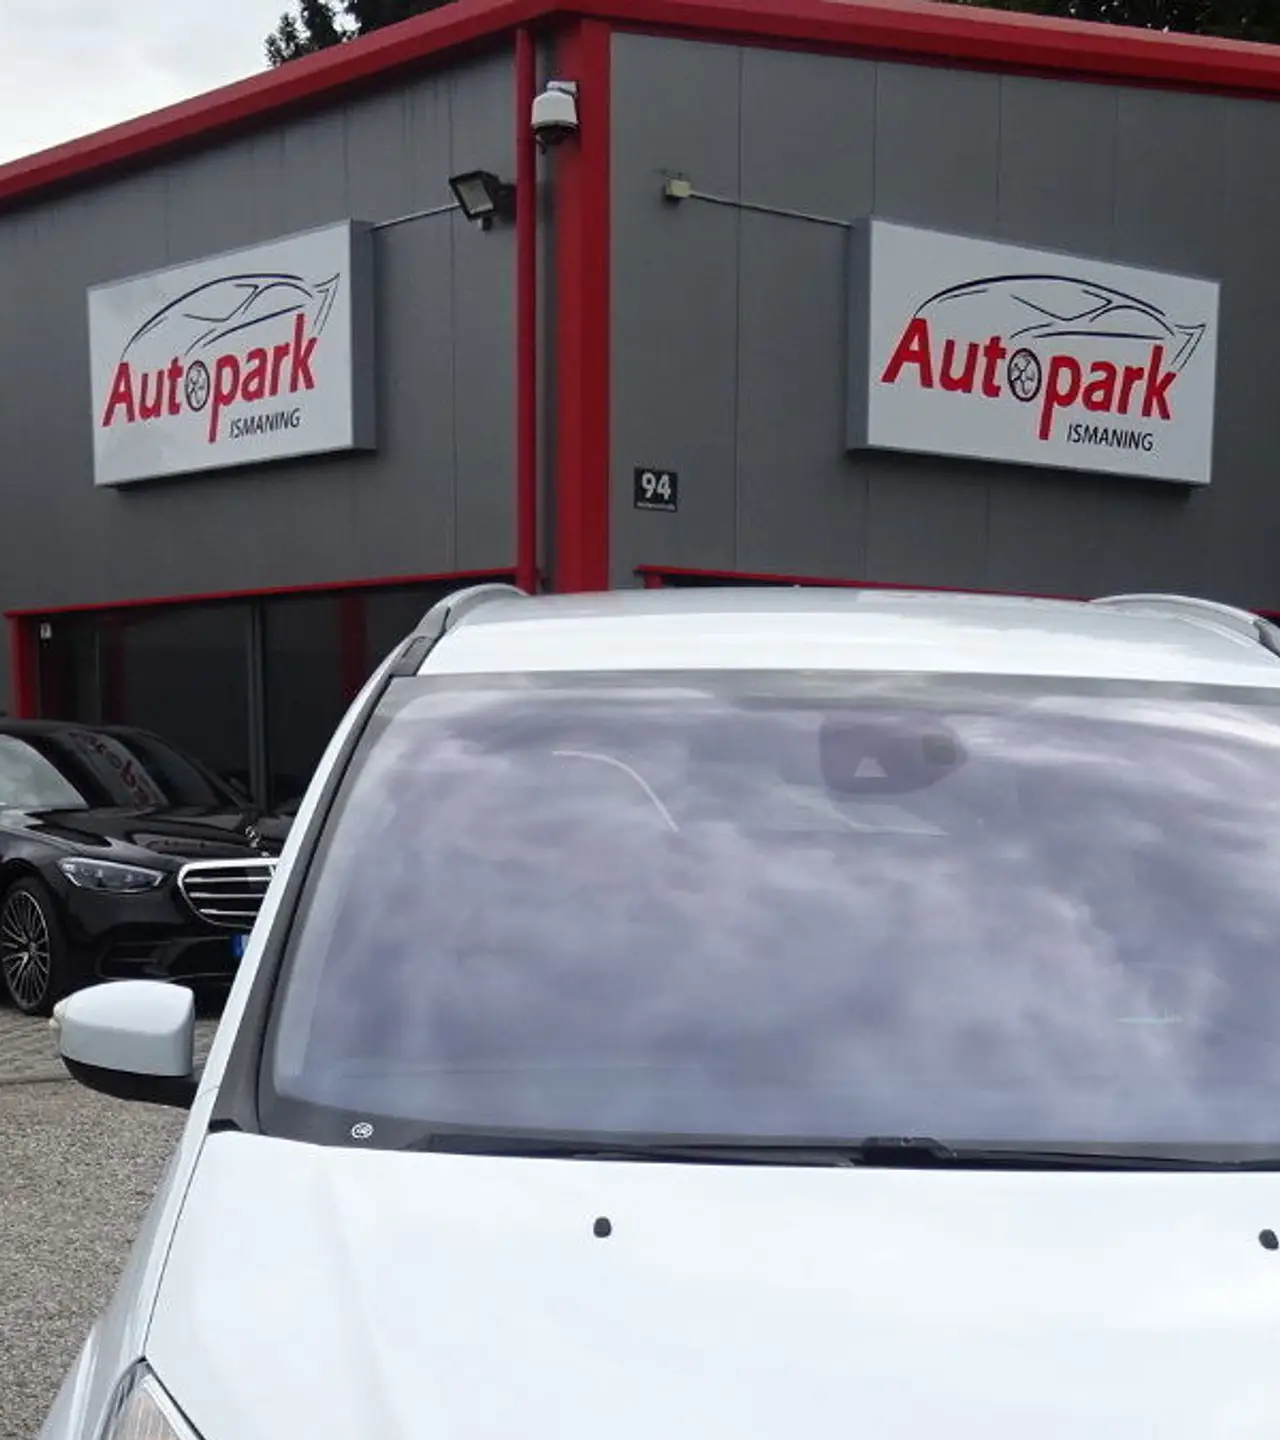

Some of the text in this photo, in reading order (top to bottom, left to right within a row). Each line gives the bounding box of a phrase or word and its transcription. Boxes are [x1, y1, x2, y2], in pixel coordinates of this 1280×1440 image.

[102, 313, 318, 443] Autopark
[881, 317, 1177, 441] Autopark
[228, 407, 302, 440] ISMANING
[1066, 423, 1154, 452] ISMANING
[641, 471, 672, 500] 94
